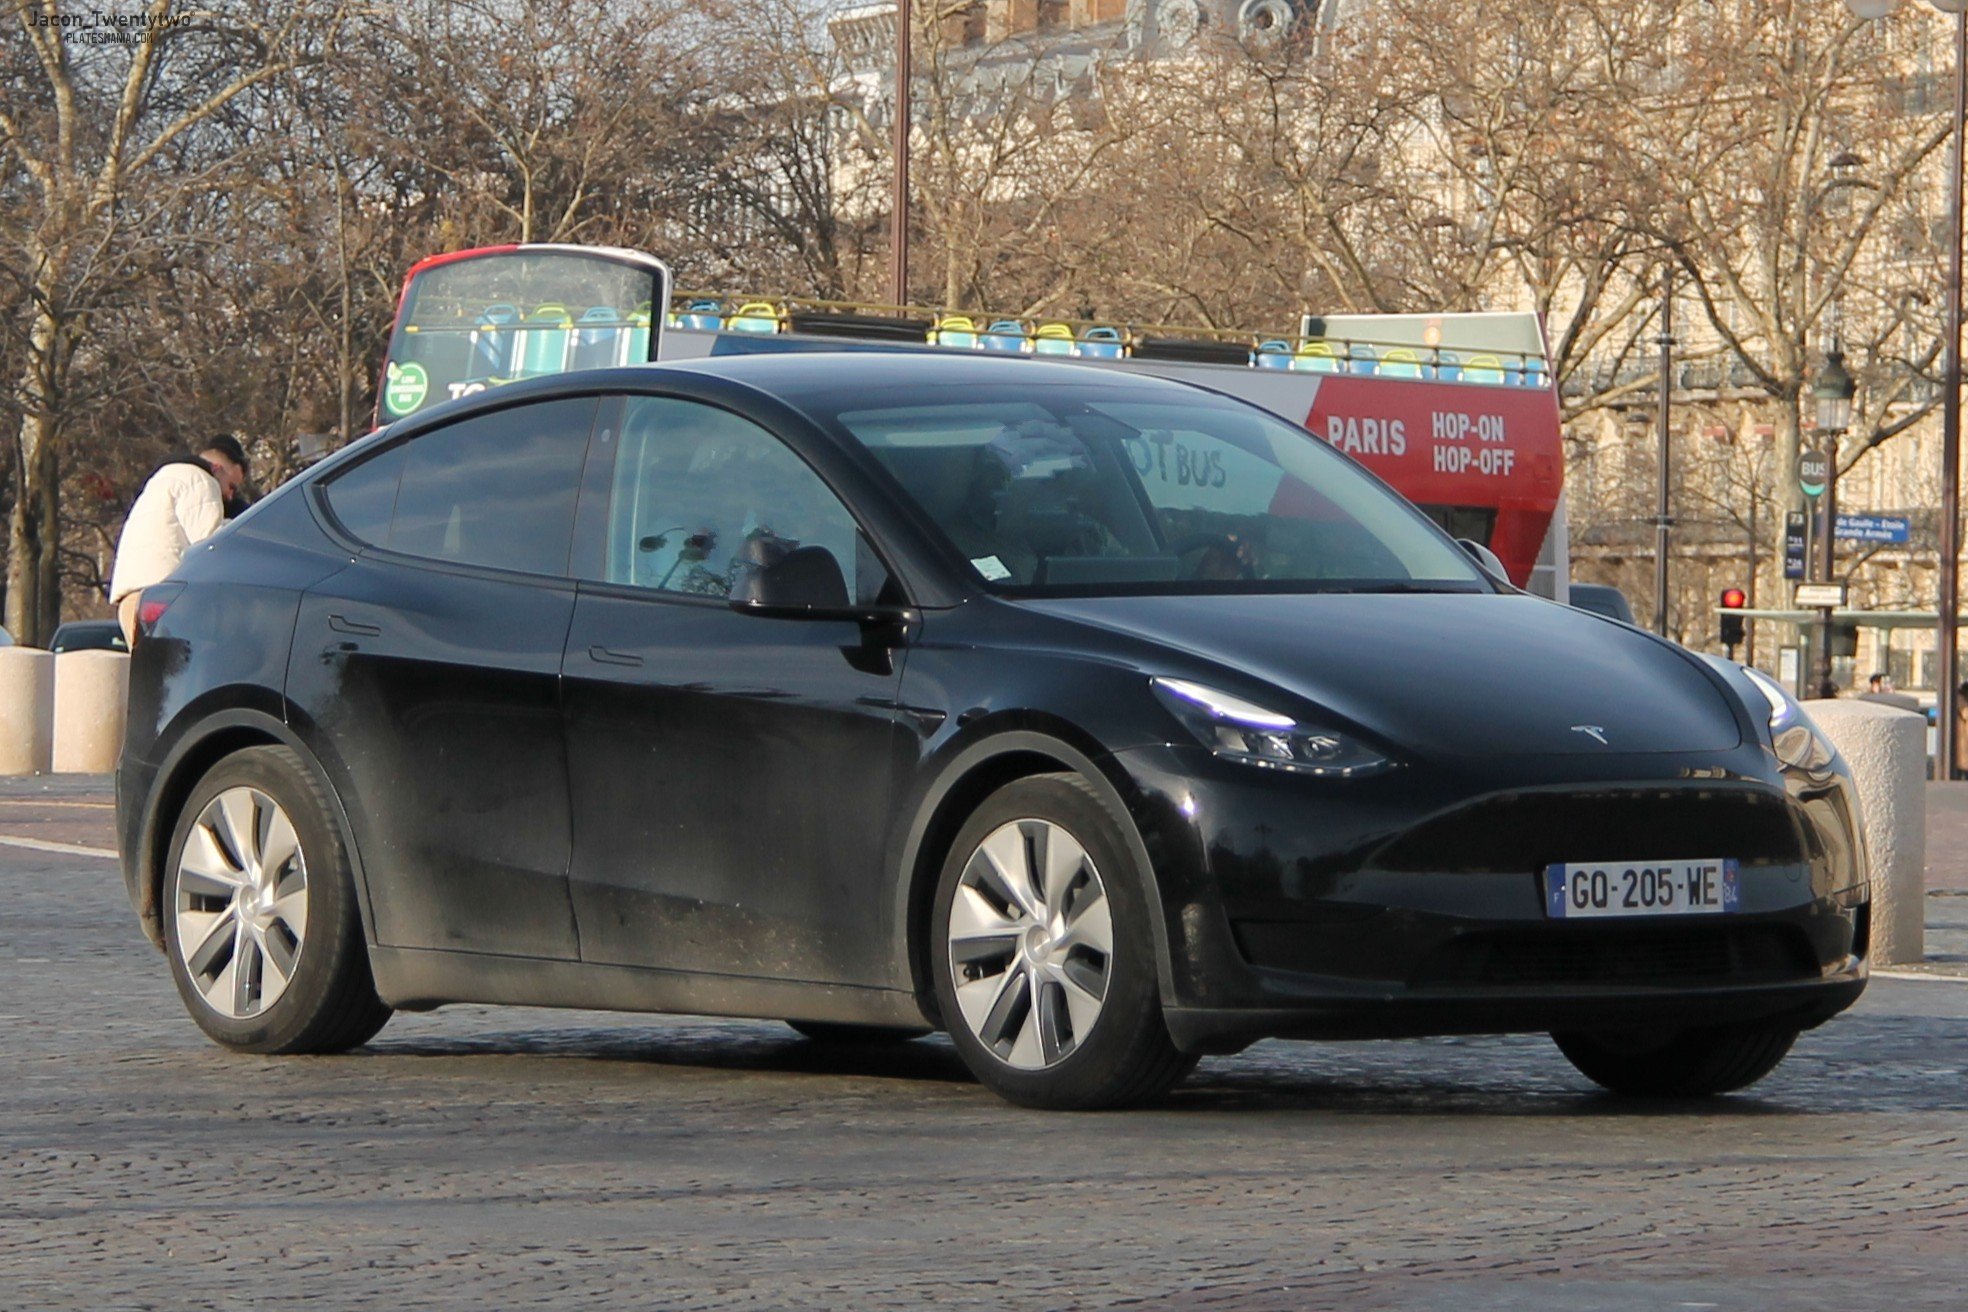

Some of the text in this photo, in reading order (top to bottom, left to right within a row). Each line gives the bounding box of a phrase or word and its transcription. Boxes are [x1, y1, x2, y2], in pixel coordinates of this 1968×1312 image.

[1327, 415, 1406, 456] PARIS
[1432, 411, 1505, 442] HOP-ON
[1433, 445, 1515, 476] HOP-OFF
[1801, 461, 1825, 476] BUS
[1572, 866, 1719, 909] GQ-205-WE
